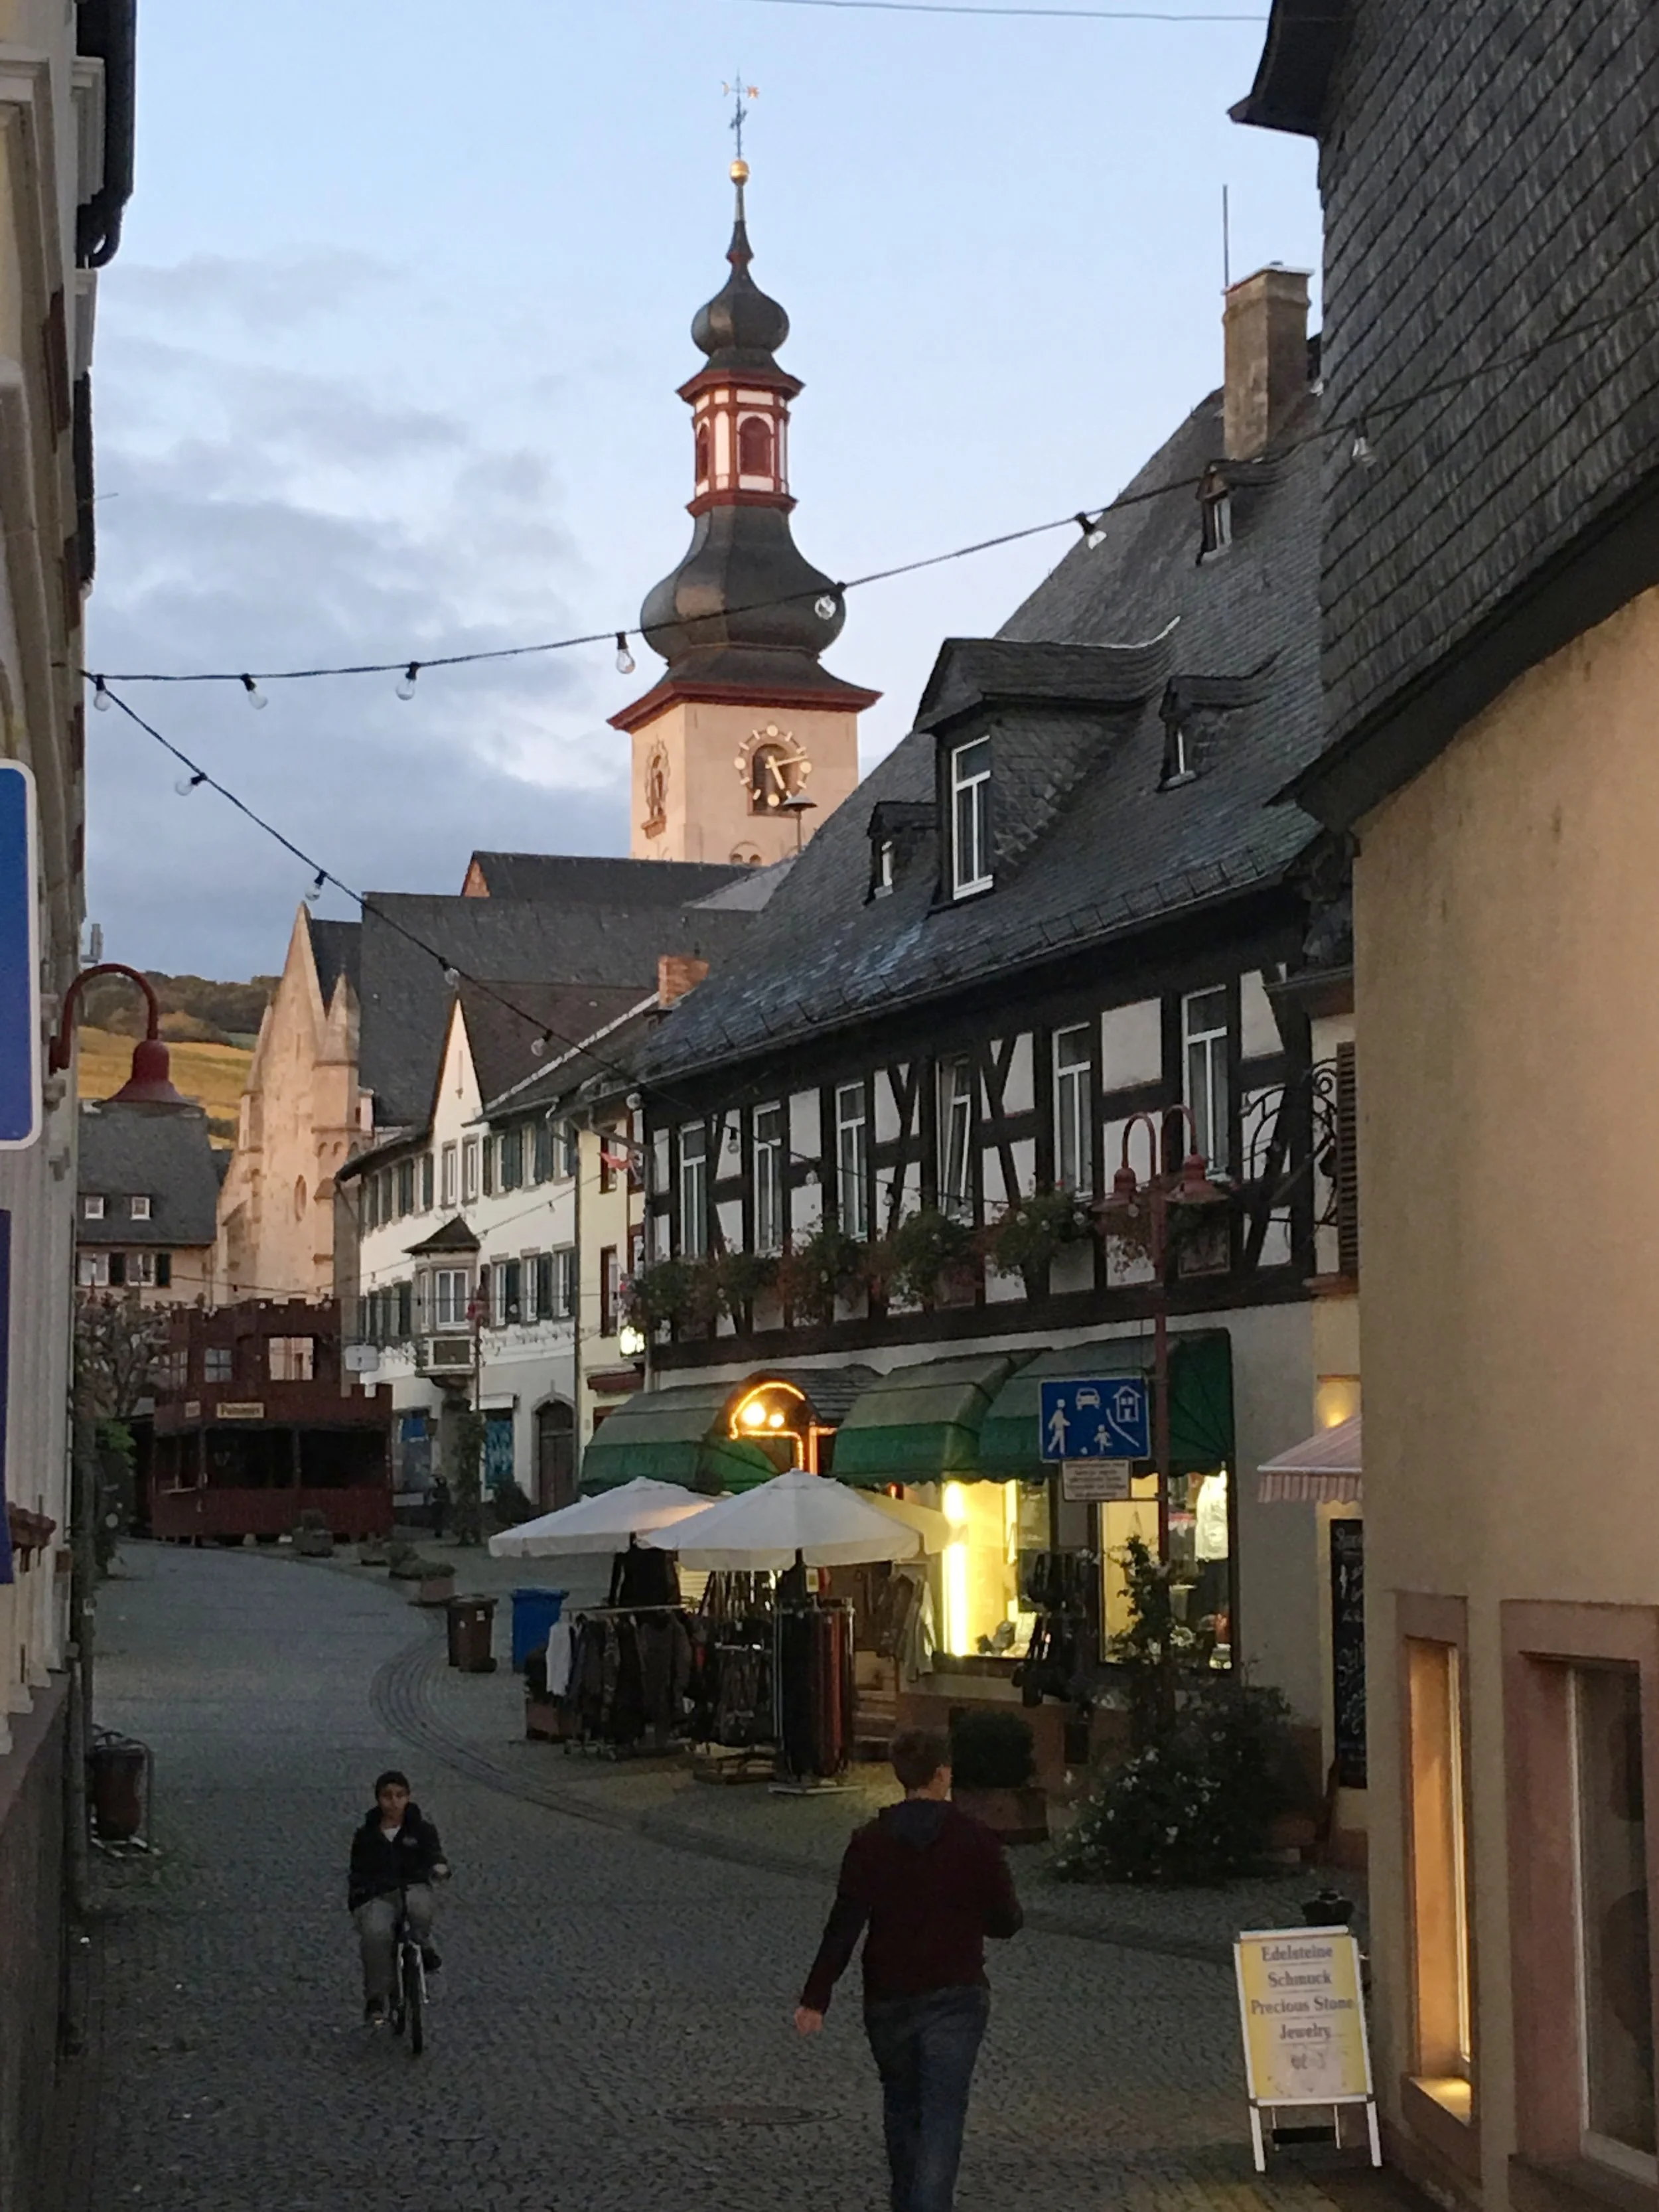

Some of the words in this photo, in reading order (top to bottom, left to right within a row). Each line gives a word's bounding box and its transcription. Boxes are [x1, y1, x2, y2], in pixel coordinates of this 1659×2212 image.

[1262, 1944, 1333, 1962] Edelsteine
[1267, 1969, 1333, 1988] Schmuck
[1251, 1998, 1310, 2015] Precious
[1279, 2022, 1331, 2040] Jewelry
